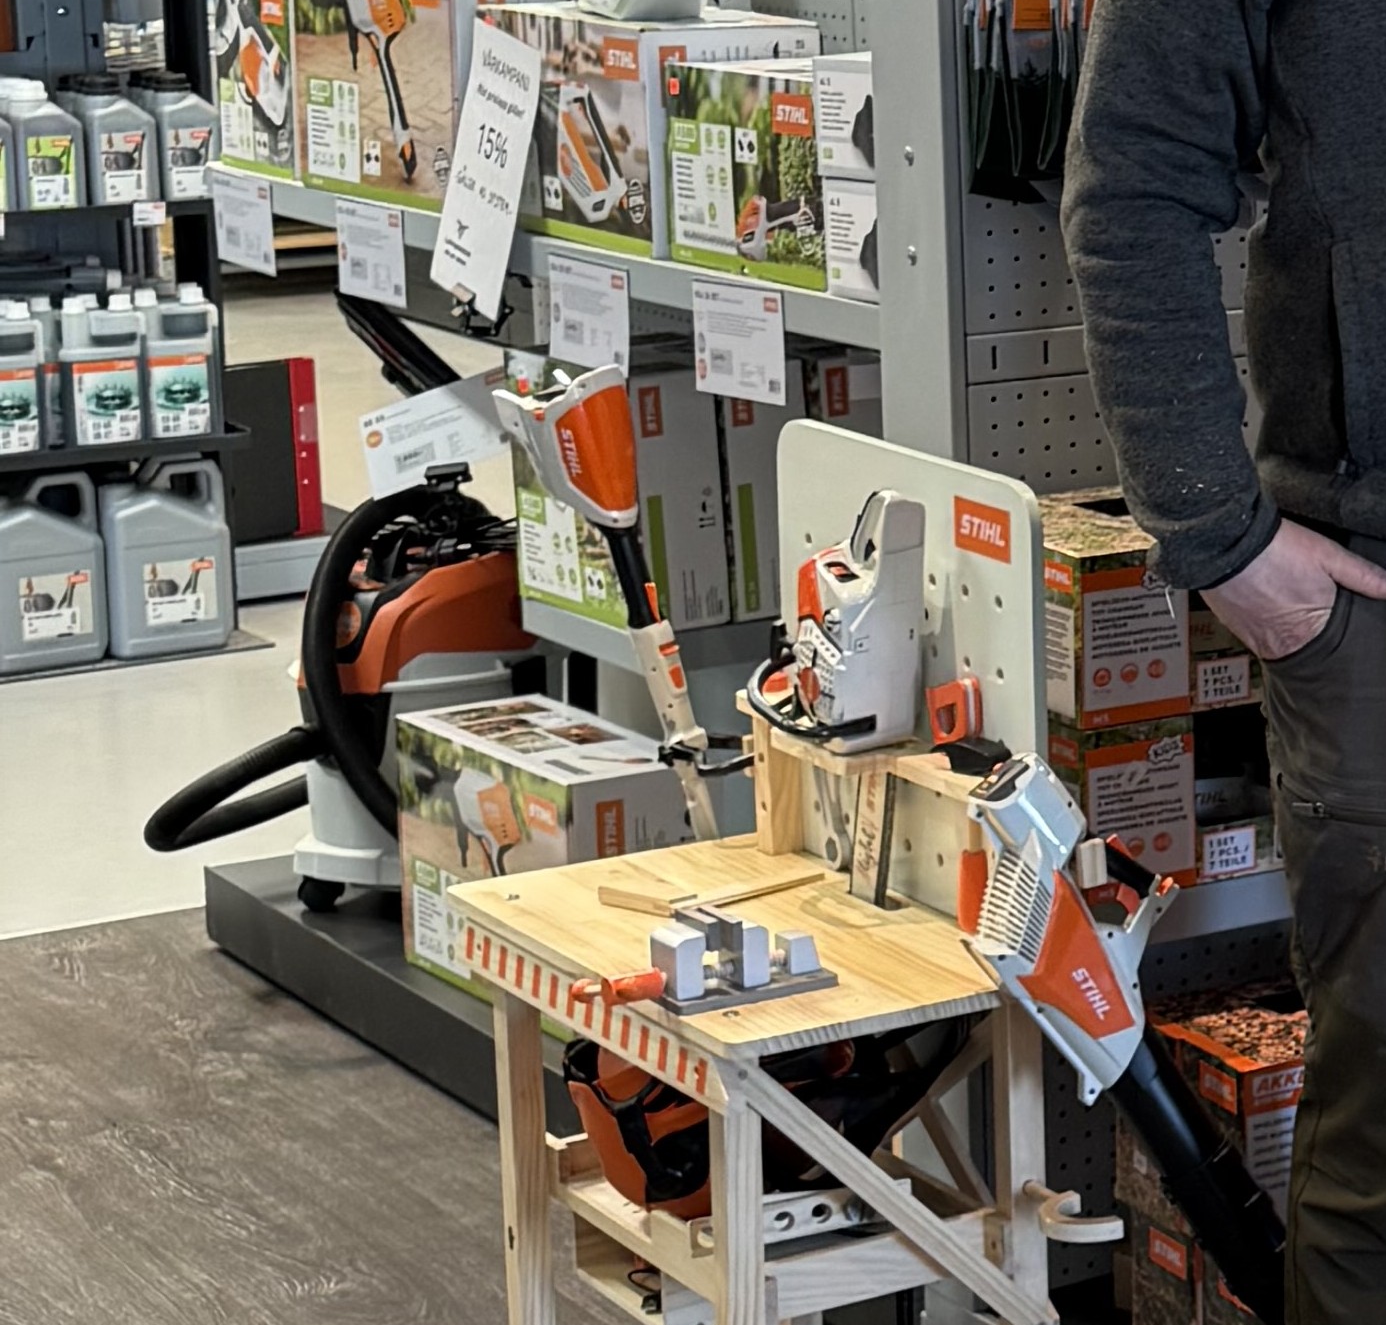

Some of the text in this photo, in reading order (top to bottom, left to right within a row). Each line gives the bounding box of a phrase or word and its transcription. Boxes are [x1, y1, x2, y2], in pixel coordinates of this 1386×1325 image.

[606, 49, 637, 69] STIHL
[775, 105, 810, 125] STIHL
[477, 123, 508, 169] 15%
[561, 428, 582, 477] STIHL
[960, 513, 1006, 547] STIHL
[1195, 791, 1227, 806] TIHL
[604, 807, 617, 855] STIHL
[1217, 836, 1235, 848] SET
[1218, 857, 1247, 869] TEILE
[1071, 966, 1110, 1022] STIHL
